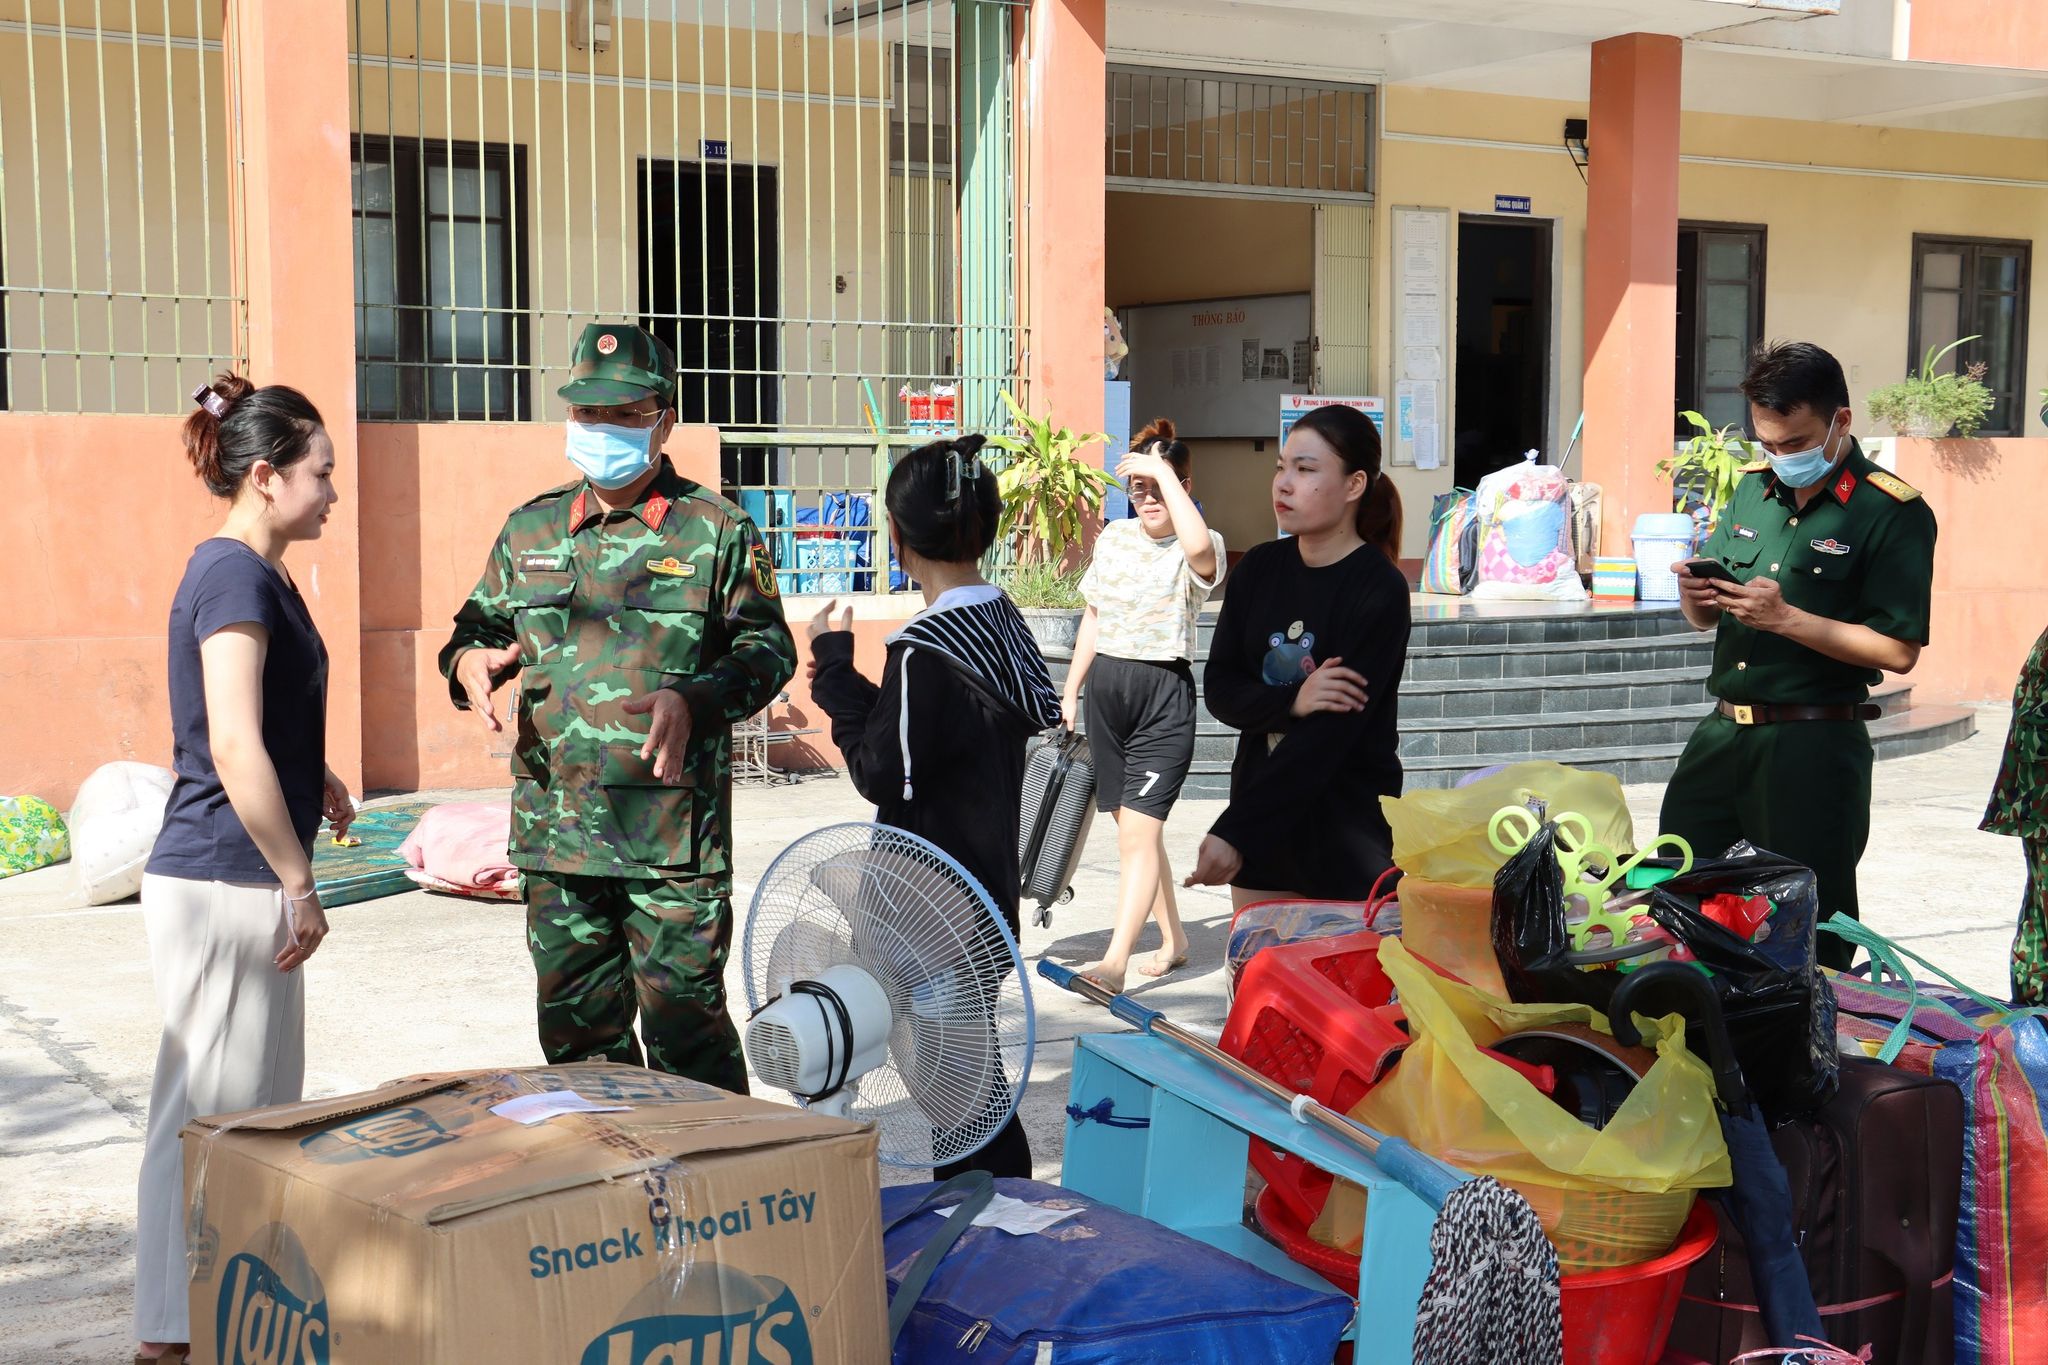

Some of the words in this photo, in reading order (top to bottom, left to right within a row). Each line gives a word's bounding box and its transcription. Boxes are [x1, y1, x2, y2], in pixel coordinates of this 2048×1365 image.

[1192, 310, 1223, 327] THÔNG
[1138, 770, 1160, 797] 7
[529, 1227, 643, 1279] Snack
[653, 1201, 752, 1251] Khoai
[760, 1188, 817, 1226] Tây
